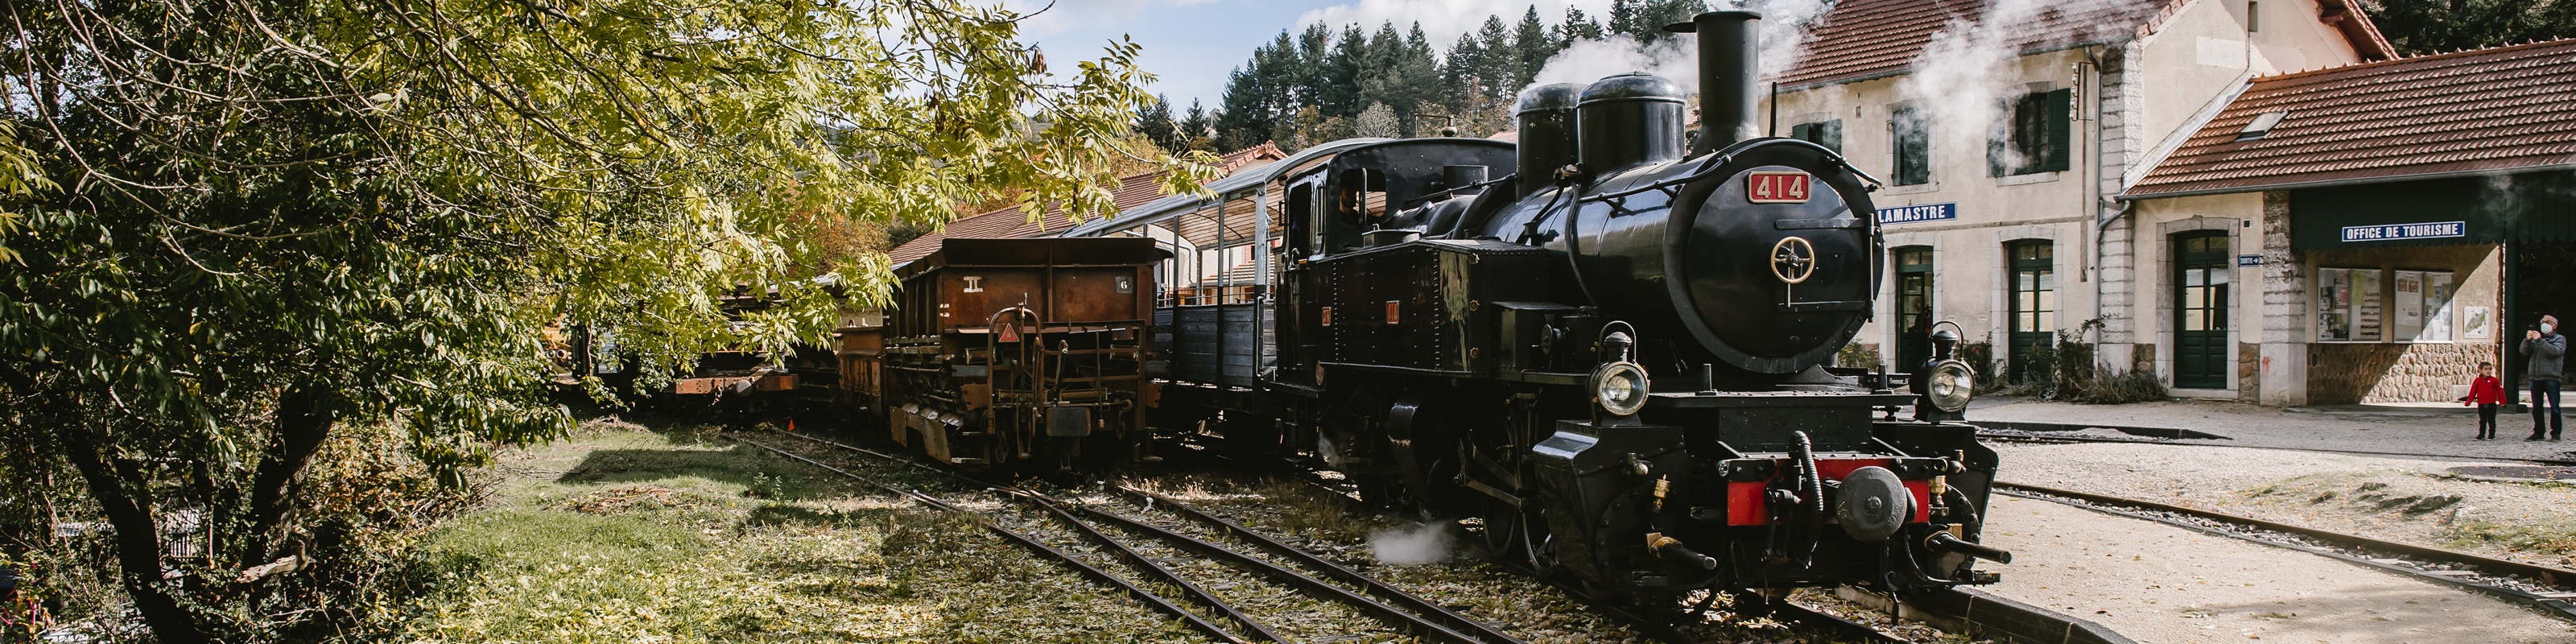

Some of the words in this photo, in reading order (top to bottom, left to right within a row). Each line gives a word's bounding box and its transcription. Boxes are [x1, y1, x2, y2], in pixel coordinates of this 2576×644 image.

[1757, 175, 1803, 199] 414
[1877, 205, 1946, 223] LAMASTRE
[2347, 227, 2381, 240] OFFICE
[2385, 226, 2399, 238] DE
[2403, 224, 2458, 237] TOURISME
[1120, 280, 1128, 289] 6
